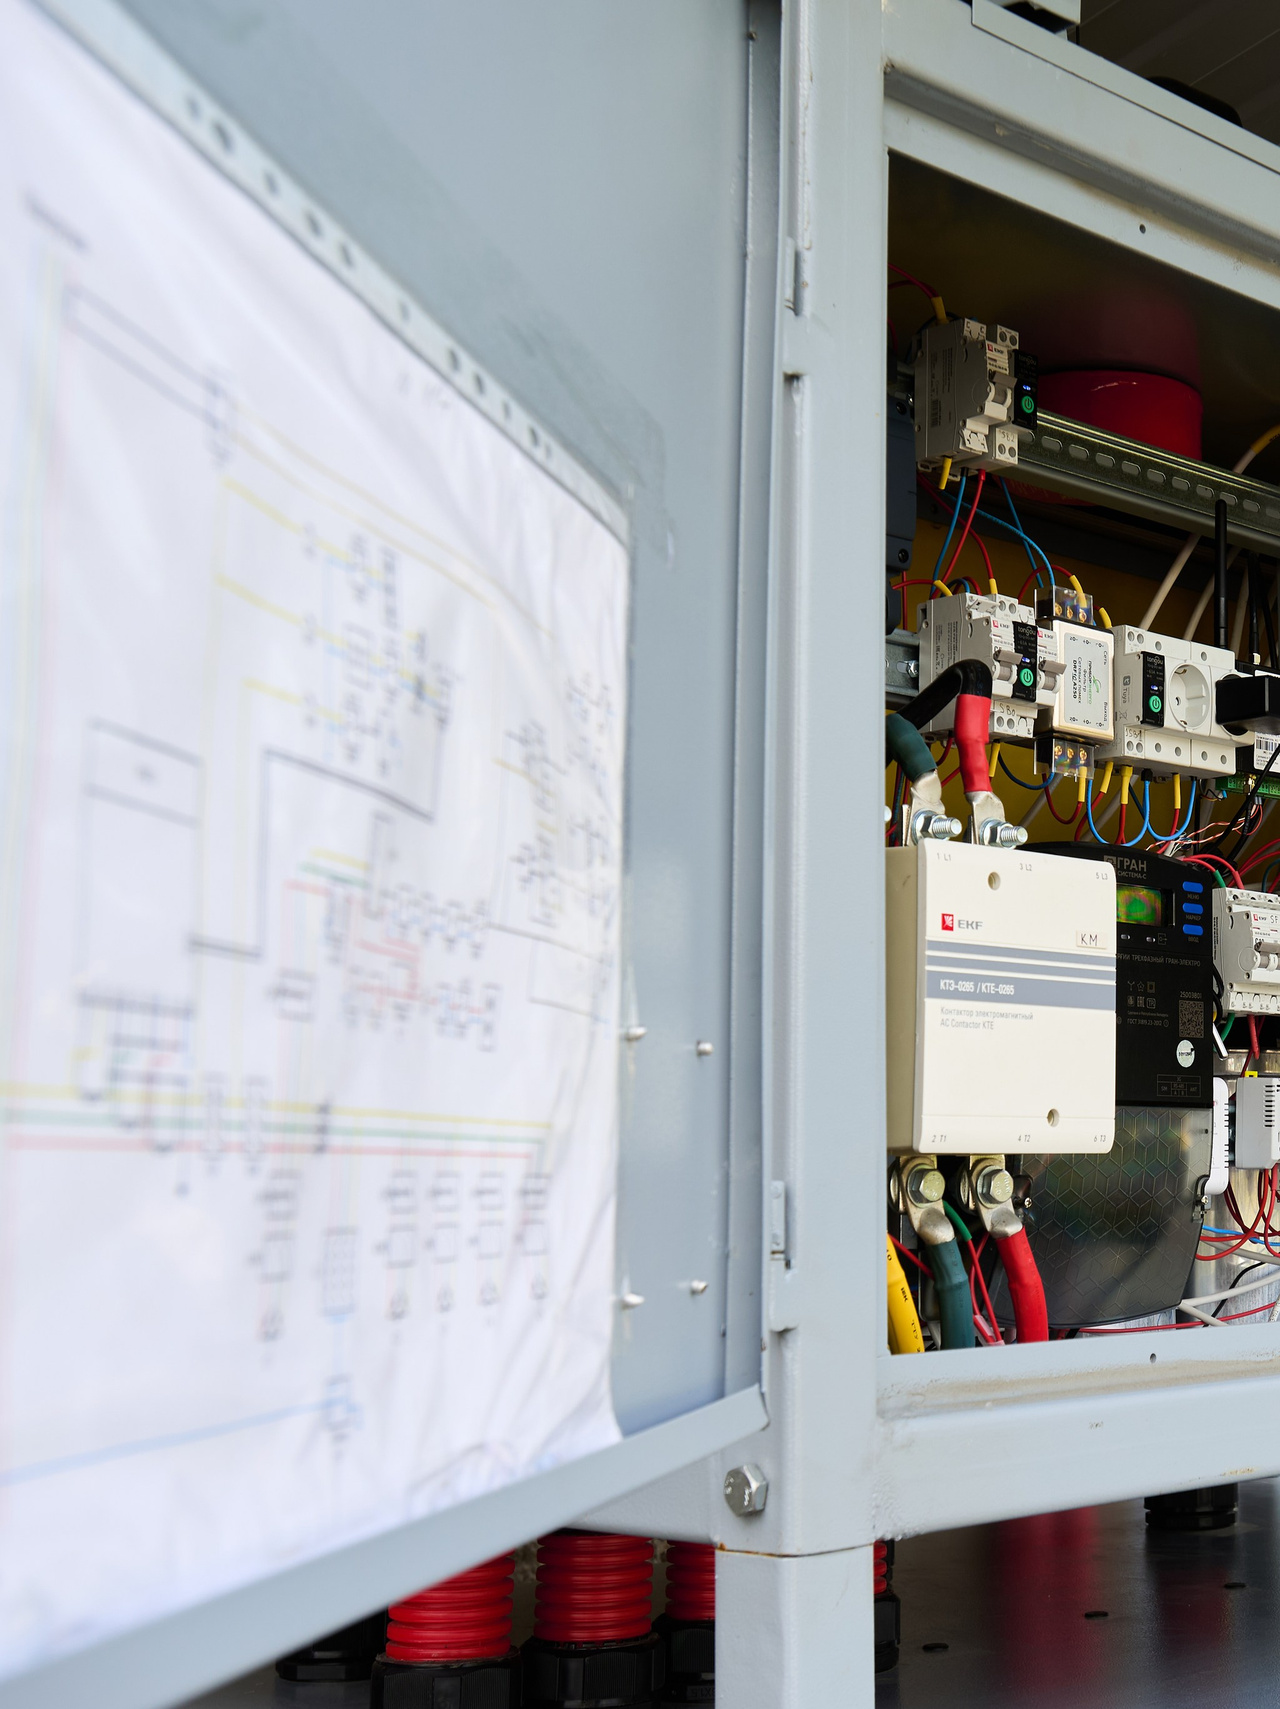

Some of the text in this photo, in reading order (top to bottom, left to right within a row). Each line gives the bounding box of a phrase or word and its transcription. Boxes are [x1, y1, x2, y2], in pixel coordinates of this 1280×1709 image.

[1117, 857, 1148, 872] ГРАН
[1117, 871, 1148, 880] СИСТЕМА-С
[957, 919, 984, 931] EKF
[1080, 933, 1098, 947] KM
[940, 1006, 1034, 1021] Контактор электромагнитный
[951, 1019, 982, 1030] Contactor
[983, 1021, 995, 1030] KTE
